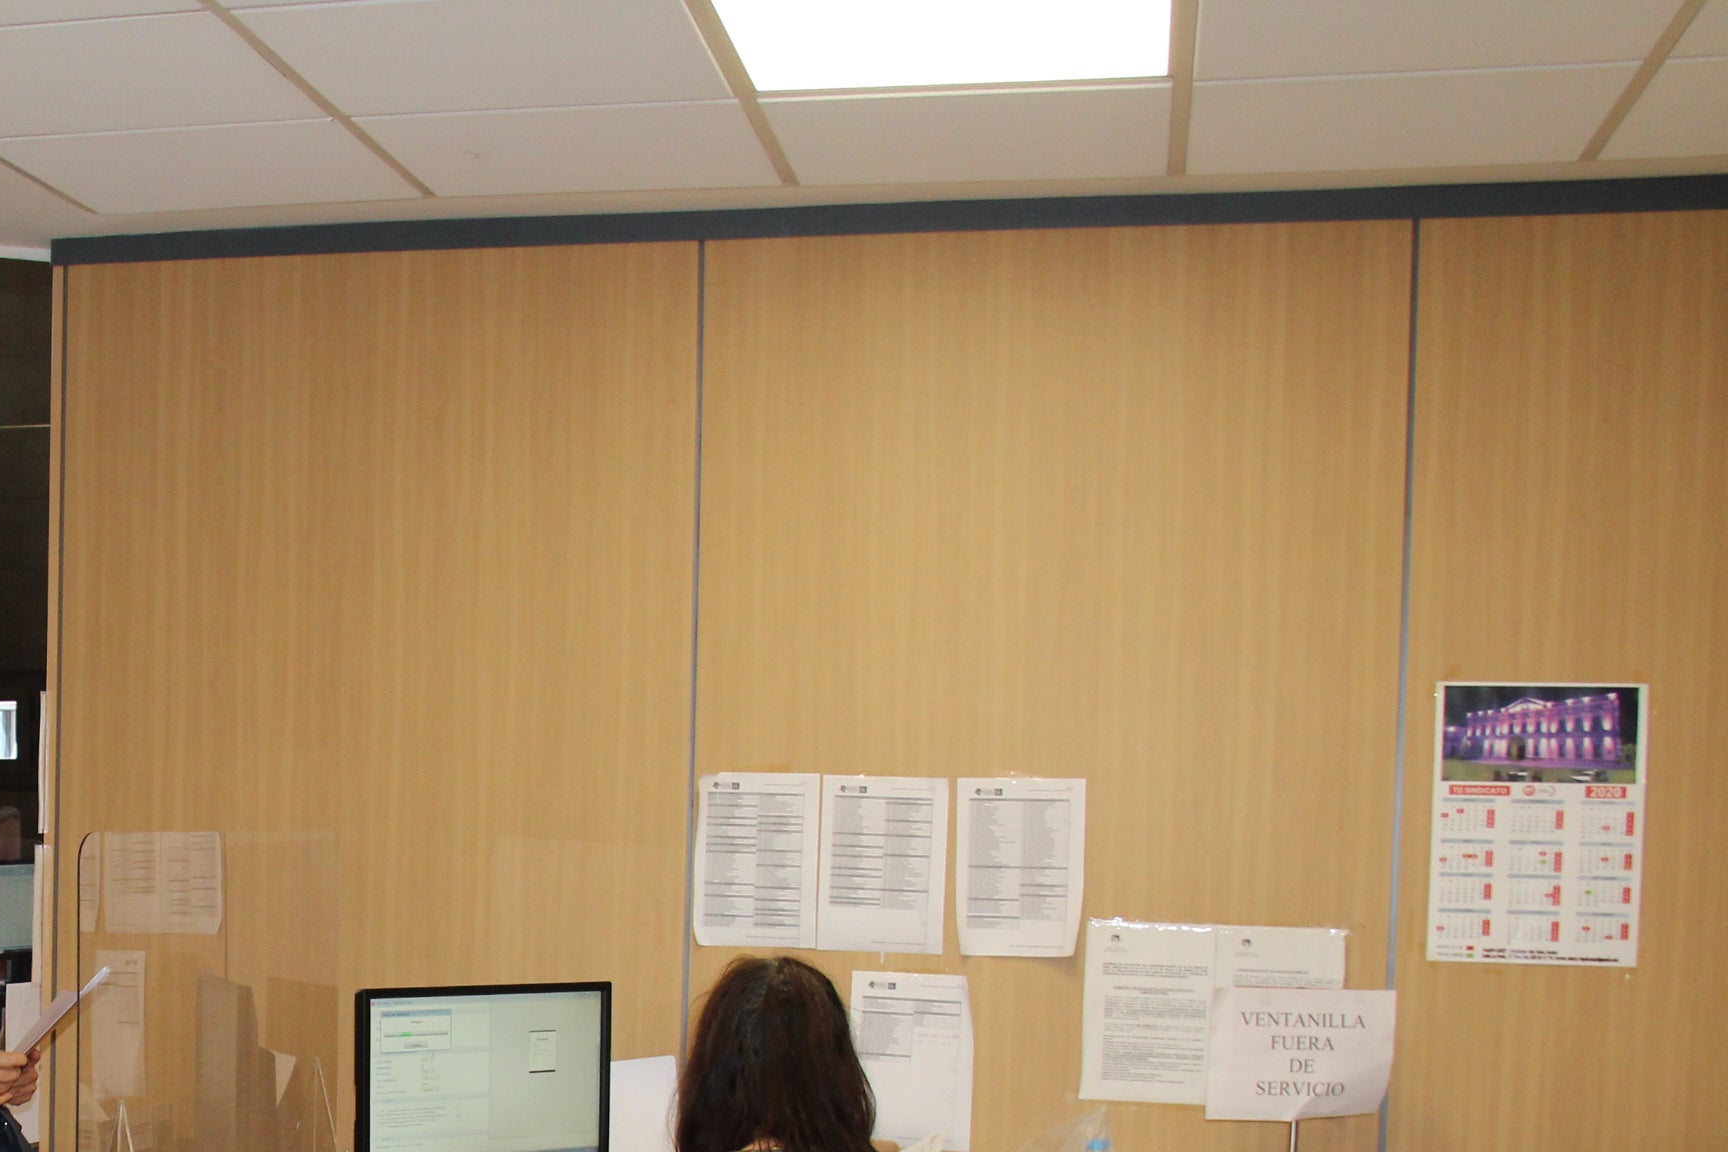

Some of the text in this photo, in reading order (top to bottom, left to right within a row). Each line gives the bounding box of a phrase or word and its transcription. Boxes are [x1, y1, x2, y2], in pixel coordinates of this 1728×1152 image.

[1590, 786, 1621, 797] 2020
[1240, 1011, 1366, 1029] VENTANILLA
[1271, 1035, 1335, 1051] FUERA
[1289, 1058, 1315, 1073] DE
[1255, 1081, 1345, 1097] SERVICIO
